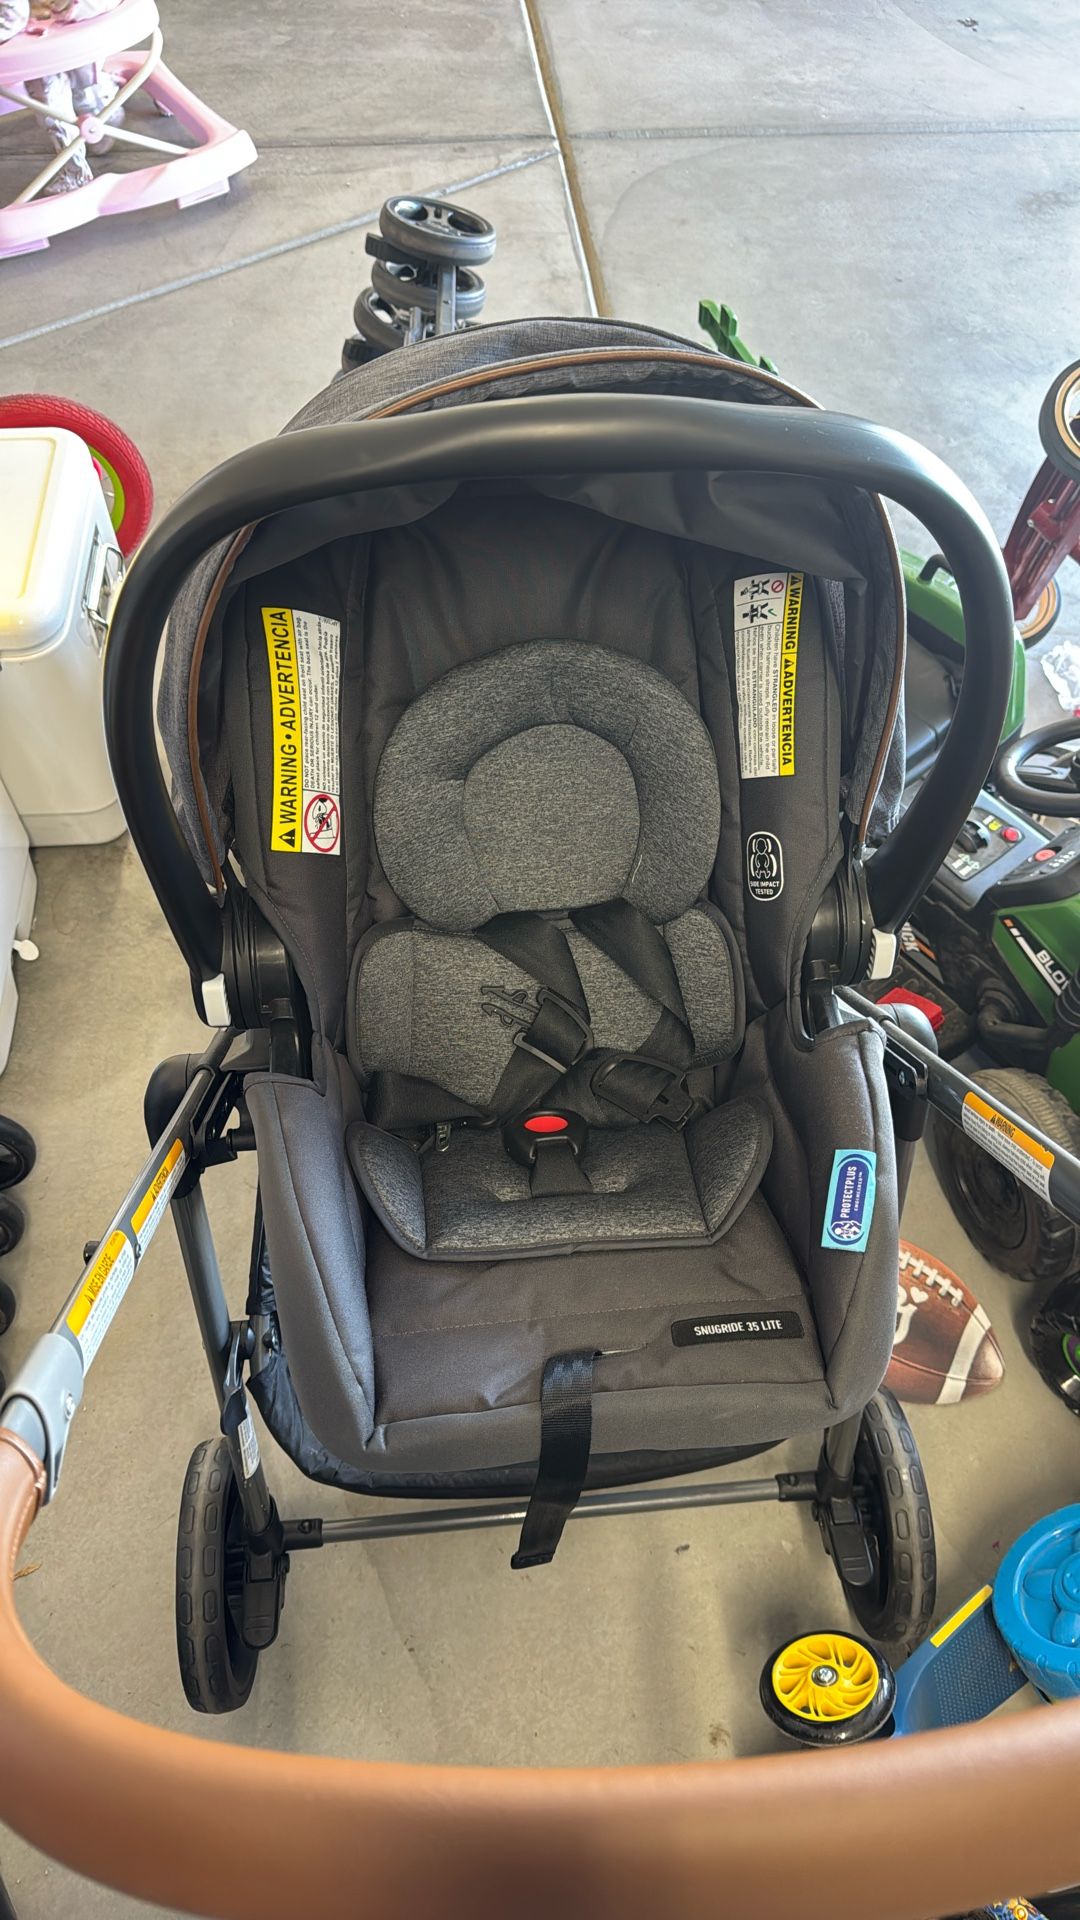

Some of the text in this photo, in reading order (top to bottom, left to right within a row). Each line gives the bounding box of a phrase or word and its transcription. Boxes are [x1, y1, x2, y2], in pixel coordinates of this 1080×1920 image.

[782, 588, 801, 766] WARNING ADVERTENCIA
[270, 611, 297, 824] WARNING ADVERTENCIA
[304, 779, 309, 788] DO
[840, 1166, 857, 1219] PROTECTPLUS
[694, 1320, 783, 1336] SNUGRIDE 35 LITE
